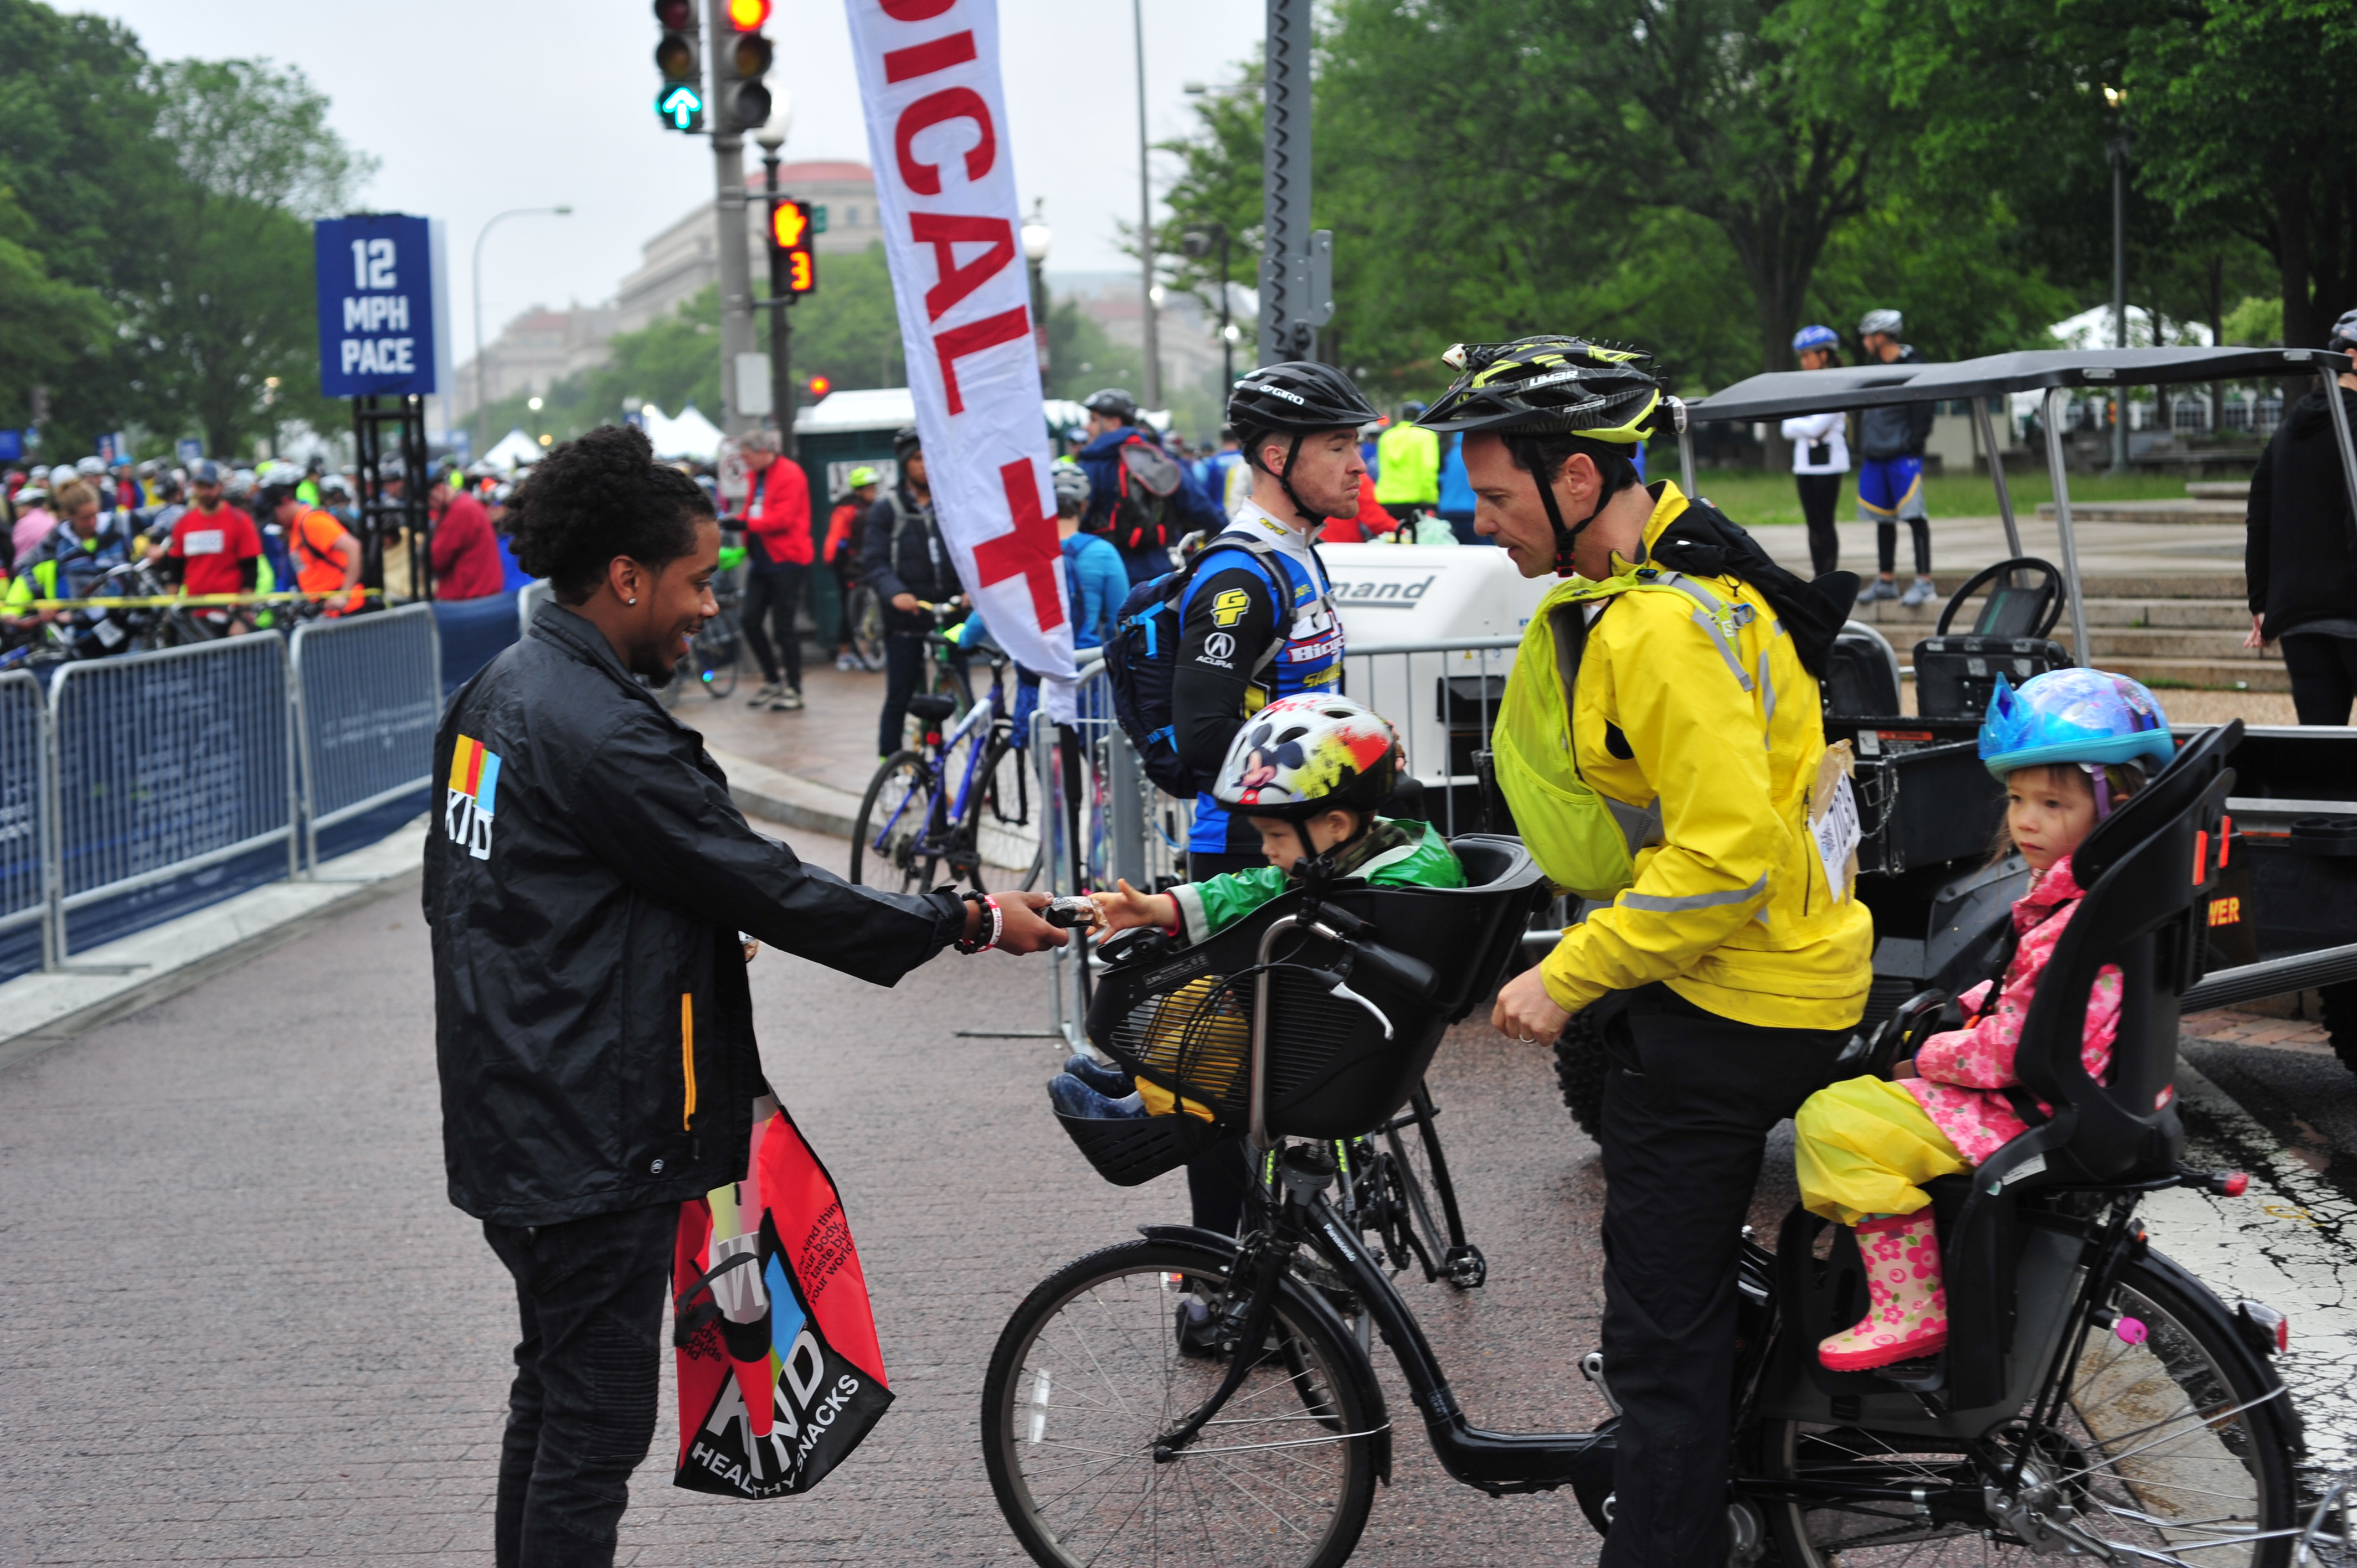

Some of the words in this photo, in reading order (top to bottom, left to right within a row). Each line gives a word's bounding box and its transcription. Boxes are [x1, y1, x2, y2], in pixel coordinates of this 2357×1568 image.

[351, 238, 397, 290] 12
[343, 295, 410, 332] MPH
[341, 337, 416, 375] PACE
[1272, 387, 1305, 405] GIRO
[1213, 589, 1249, 626] GT
[1195, 655, 1234, 669] ACURA
[445, 788, 495, 860] KID
[802, 1225, 821, 1254] kind
[803, 1252, 816, 1281] your
[813, 1221, 842, 1252] body,
[1323, 1223, 1356, 1262] Panasonic
[809, 1275, 828, 1307] your
[825, 1240, 854, 1276] world
[810, 1248, 835, 1279] taste
[692, 1441, 796, 1499] HEALTHY
[796, 1374, 859, 1473] SNACKS
